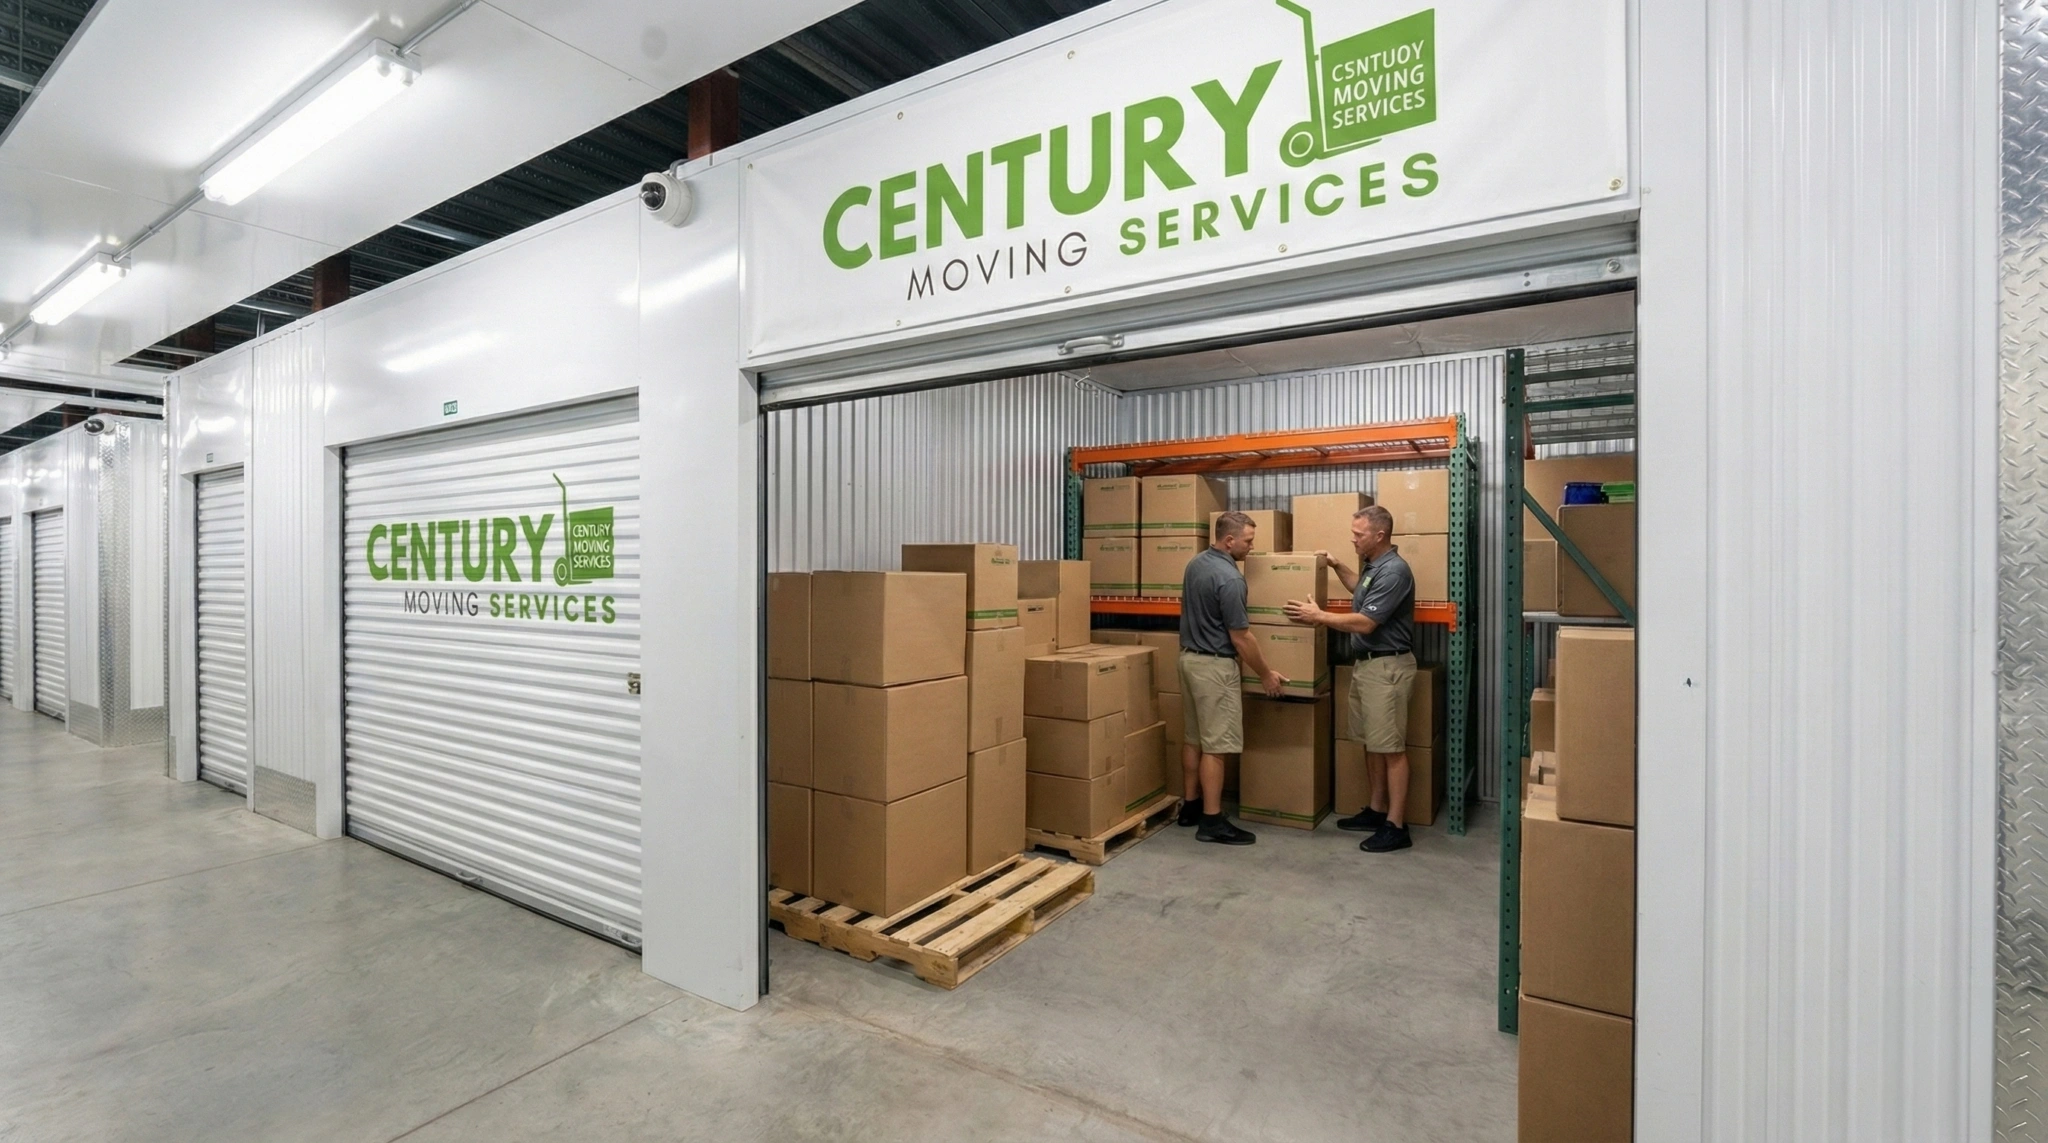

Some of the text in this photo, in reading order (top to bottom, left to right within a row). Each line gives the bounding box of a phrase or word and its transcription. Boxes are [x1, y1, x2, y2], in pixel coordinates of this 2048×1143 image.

[1331, 39, 1425, 82] CSNTUOY
[1333, 63, 1425, 107] MOVING
[1332, 88, 1426, 129] SERVICES
[823, 60, 1282, 269] CENTURY
[907, 152, 1439, 300] MOVING SERVICES
[366, 513, 555, 582] CENTURY
[572, 523, 611, 538] CENTURY
[573, 539, 610, 553] MOVING
[573, 554, 611, 569] SERVICES
[404, 590, 616, 624] MOVING SERVICES
